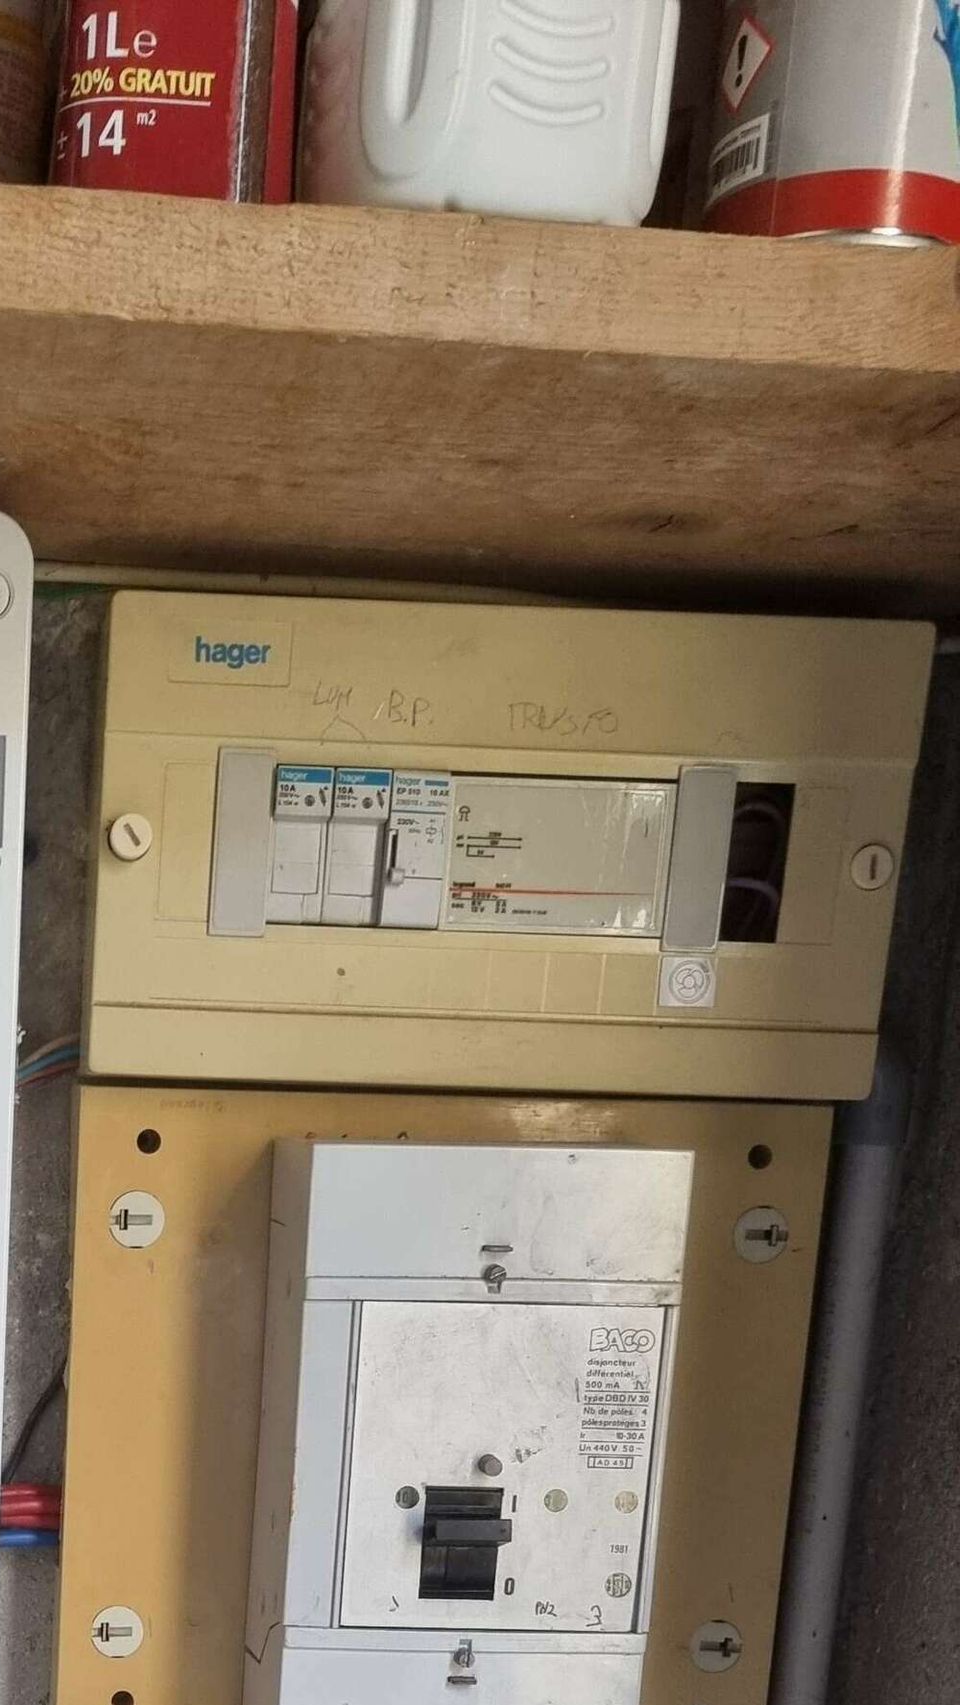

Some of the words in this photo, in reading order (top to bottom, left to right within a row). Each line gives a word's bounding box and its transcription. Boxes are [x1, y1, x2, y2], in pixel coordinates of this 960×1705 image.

[70, 66, 115, 99] 20%
[118, 66, 216, 98] GRATUIT
[76, 109, 127, 159] 14
[194, 635, 272, 670] hager
[280, 770, 308, 783] hager
[339, 773, 366, 786] hager
[589, 1327, 656, 1353] BACO
[585, 1381, 603, 1389] 500
[605, 1381, 620, 1389] mA
[583, 1394, 604, 1404] type
[639, 1395, 649, 1403] 30
[583, 1407, 596, 1416] Nb
[598, 1408, 608, 1416] de
[641, 1408, 648, 1416] 4
[638, 1432, 645, 1440] A
[622, 1445, 634, 1453] 50
